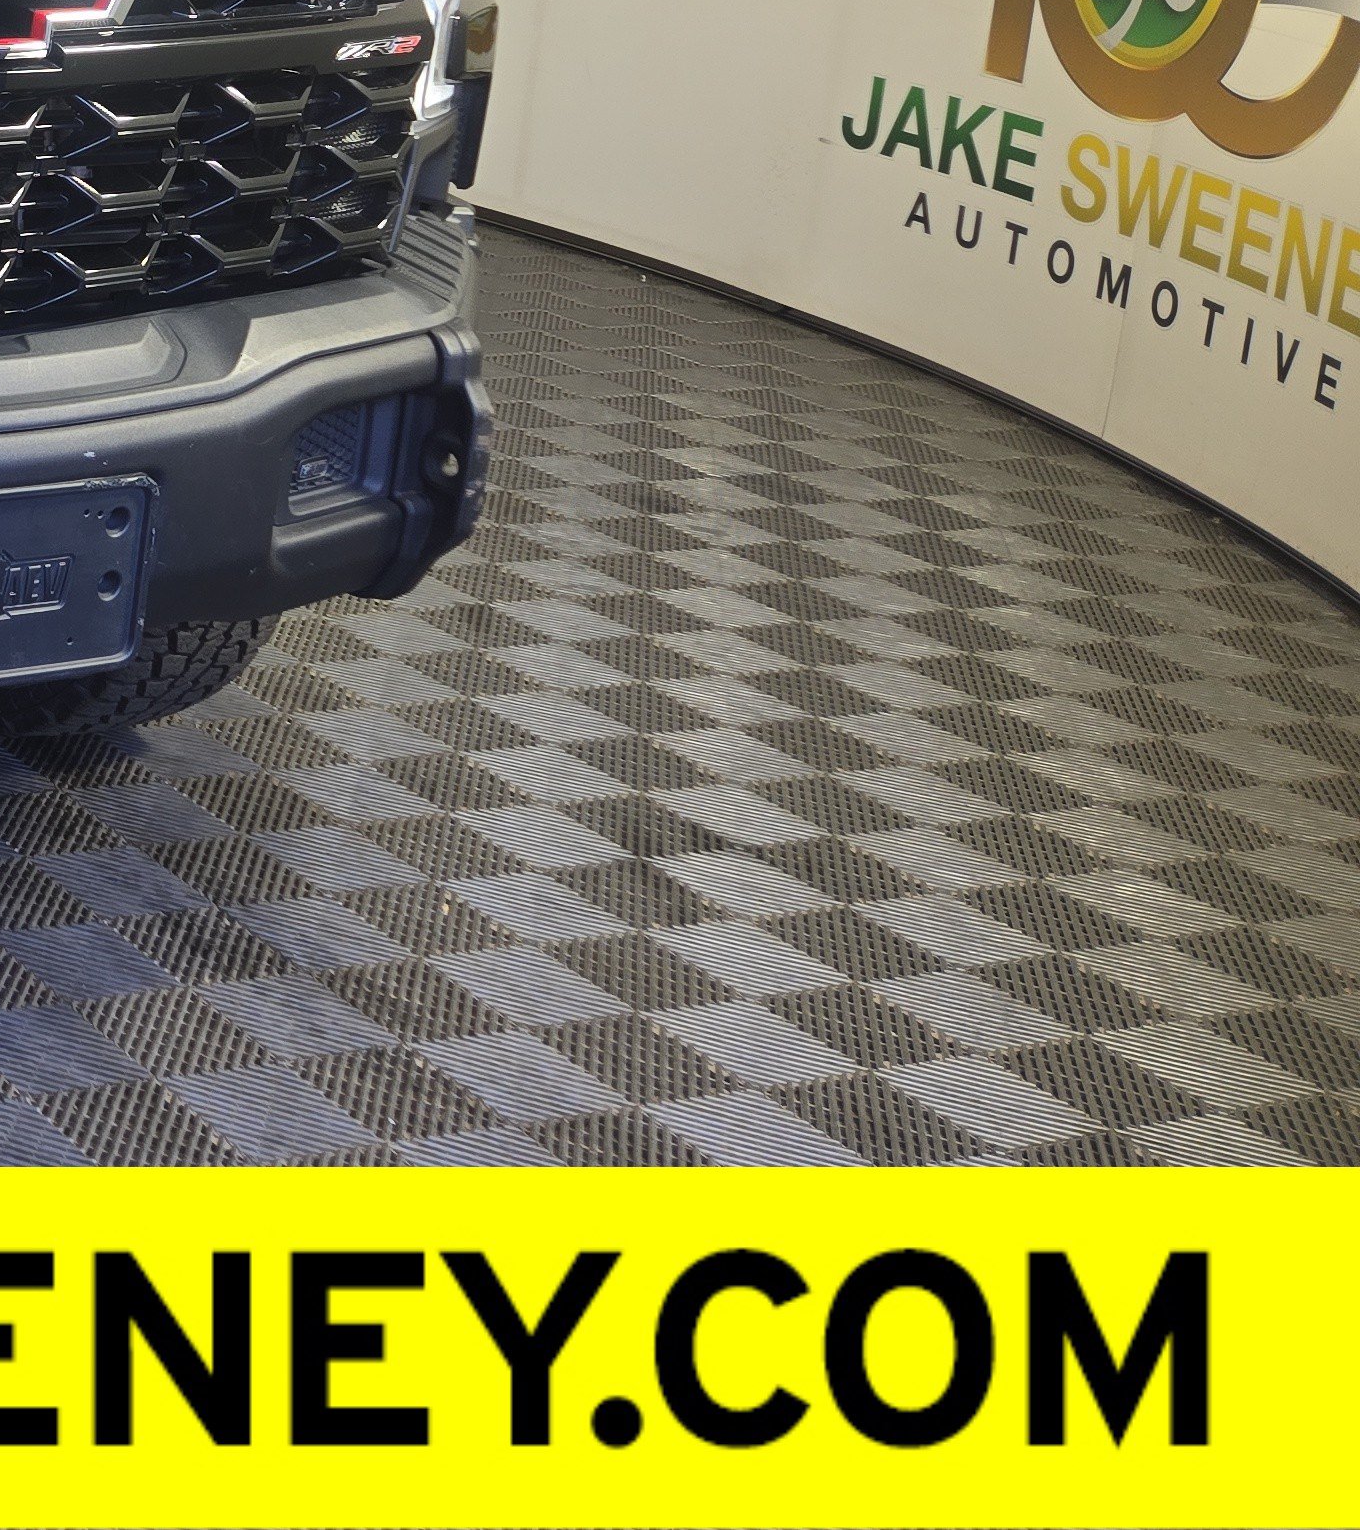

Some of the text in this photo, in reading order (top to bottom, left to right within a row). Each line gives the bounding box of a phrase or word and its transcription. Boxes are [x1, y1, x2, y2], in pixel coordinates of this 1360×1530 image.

[842, 76, 1360, 339] JAKE SWEENE
[904, 191, 1342, 410] AUTOMOTIVE
